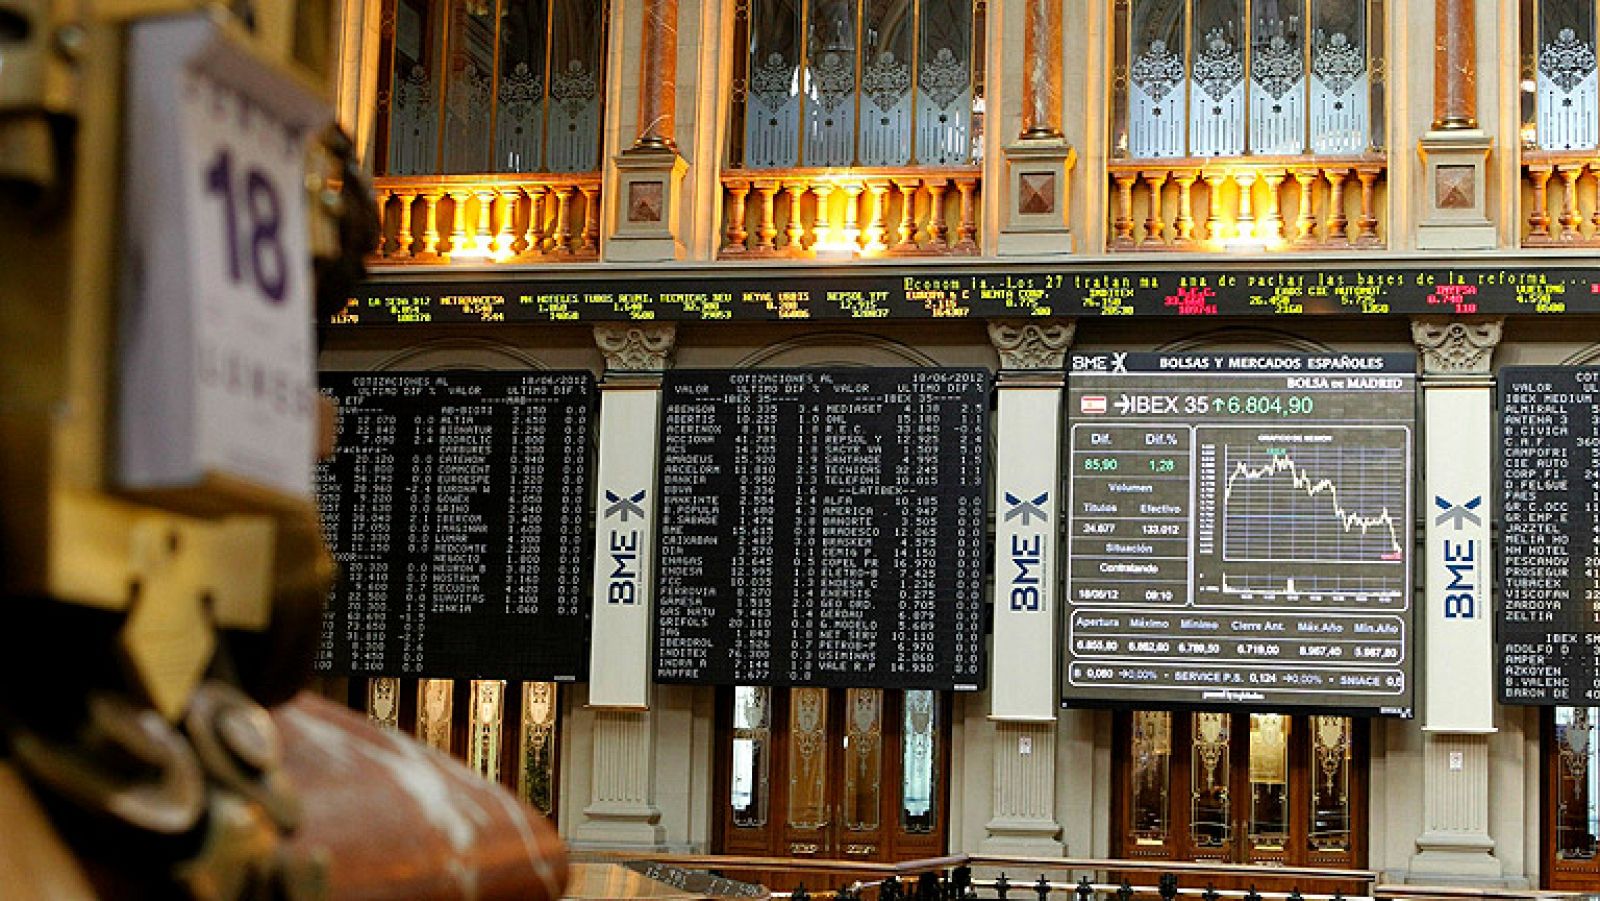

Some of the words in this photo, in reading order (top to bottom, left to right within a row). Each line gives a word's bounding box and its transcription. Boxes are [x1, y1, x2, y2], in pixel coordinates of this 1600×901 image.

[206, 148, 287, 303] 18
[1046, 274, 1062, 288] 27
[1075, 275, 1130, 288] tratan
[1218, 275, 1236, 286] de
[1248, 273, 1304, 286] pactar
[1318, 272, 1344, 286] las
[1358, 272, 1404, 285] bases
[1416, 272, 1434, 284] de
[1450, 272, 1465, 284] la
[1478, 272, 1546, 284] reforma
[1160, 356, 1209, 369] BOLSAS
[1215, 357, 1223, 368] Y
[1229, 357, 1301, 369] MERCADOS
[1308, 354, 1384, 369] ESPAÑOLES
[729, 374, 813, 384] COTIZACIONES
[1287, 377, 1329, 389] BOLSA
[1347, 378, 1403, 389] MADRID
[507, 386, 547, 395] ULTIMO
[553, 386, 575, 395] DIF
[898, 383, 940, 393] ULTIMO
[948, 383, 969, 393] DIF
[1506, 394, 1536, 403] IBEX
[1544, 394, 1592, 403] MEDIUM
[827, 404, 882, 413] MEDIASET
[1130, 396, 1178, 413] IBEX
[1185, 396, 1209, 413] 35
[1228, 397, 1313, 416] 6.804,90
[1091, 434, 1112, 445] Dif.
[1537, 459, 1569, 467] AUTO
[1108, 483, 1153, 493] Volumen
[1141, 504, 1181, 514] Efectivo
[1106, 543, 1153, 554] Situación
[1505, 546, 1521, 555] NH
[1100, 563, 1158, 574] Contratando
[1506, 601, 1561, 610] ZARDOYA
[1506, 611, 1552, 621] ZELTIA
[1076, 617, 1119, 628] Apertura
[1130, 617, 1169, 629] Máximo
[1231, 620, 1262, 631] Cierre
[1264, 621, 1285, 631] Ant.
[1174, 672, 1220, 682] SERVICE
